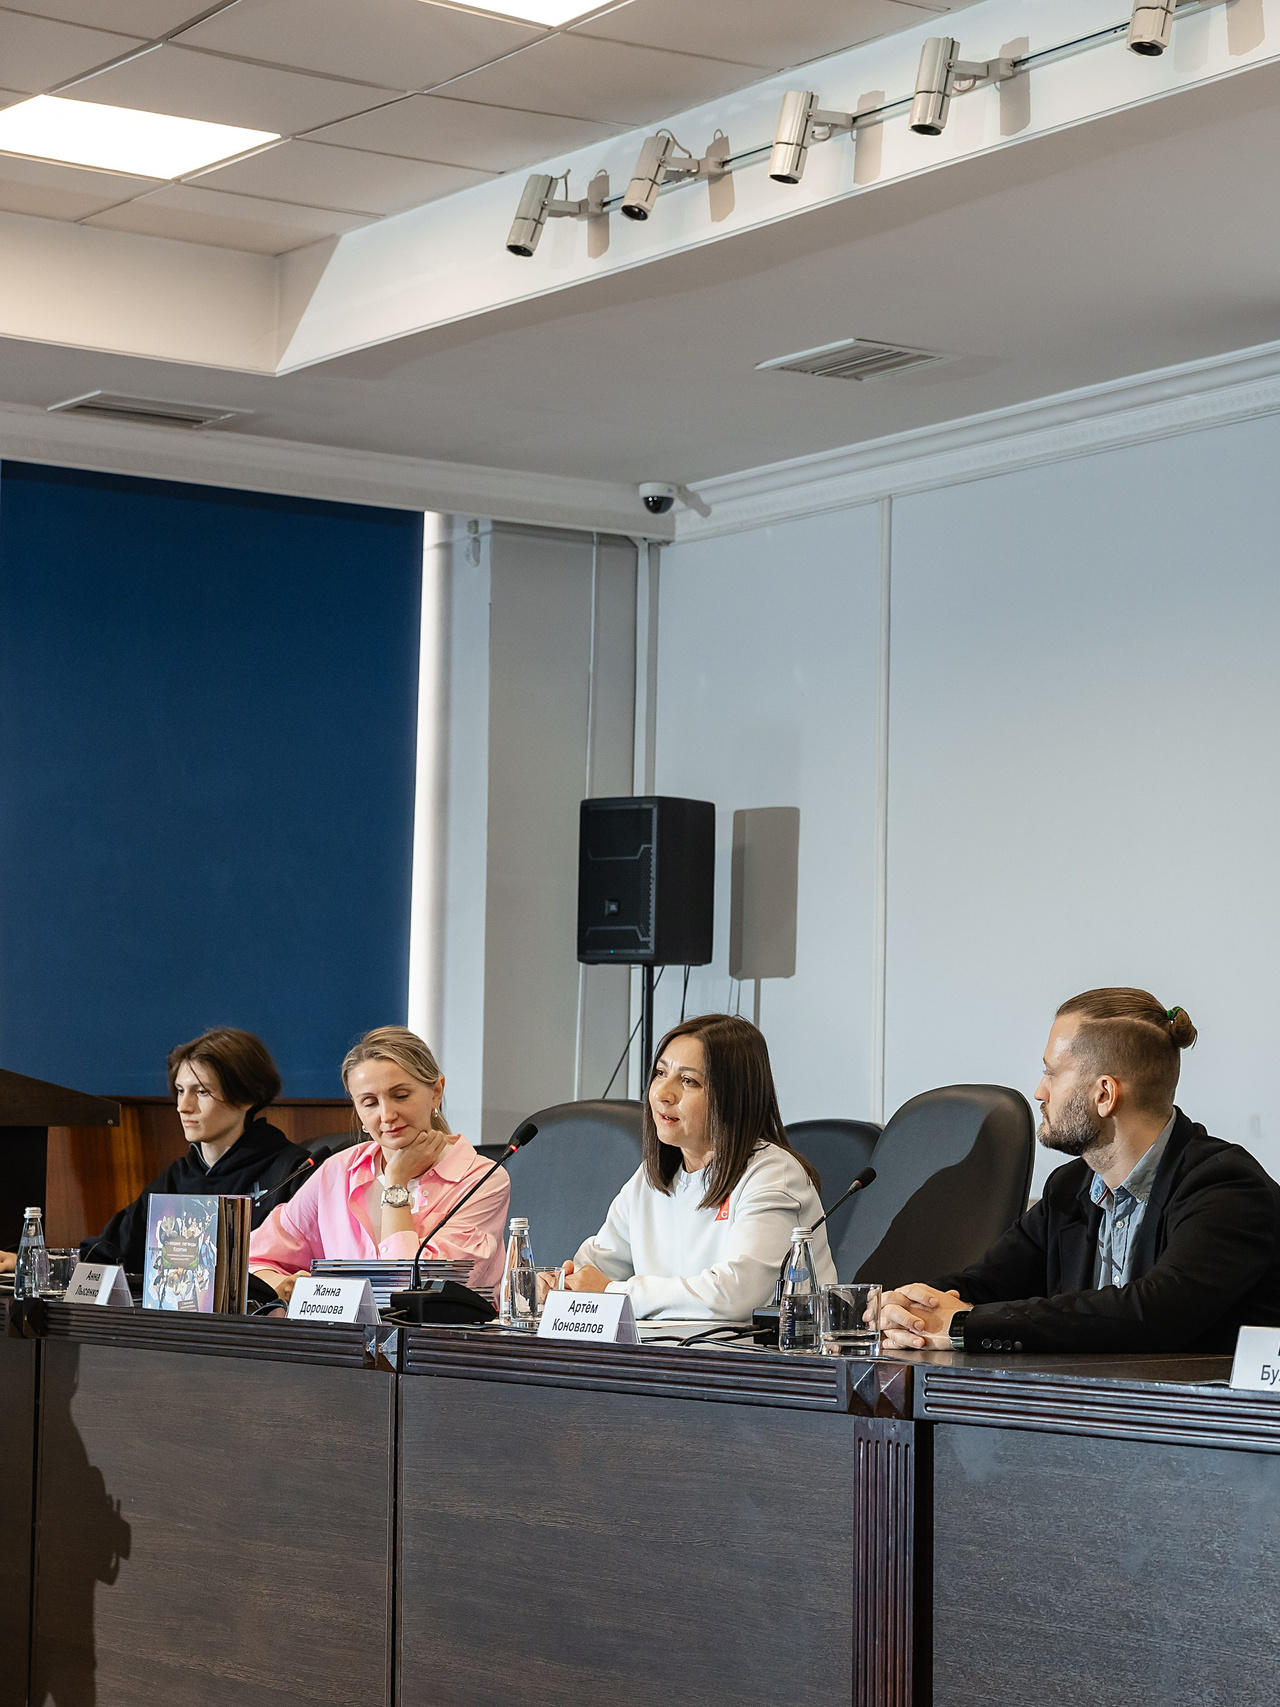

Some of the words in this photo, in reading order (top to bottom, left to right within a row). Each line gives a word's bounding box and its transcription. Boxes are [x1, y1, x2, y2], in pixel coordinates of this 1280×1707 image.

[86, 1269, 101, 1282] Анна
[313, 1284, 342, 1297] Жанна
[299, 1301, 343, 1316] Дорошова
[567, 1298, 599, 1315] Артём
[552, 1318, 604, 1334] Коновалов
